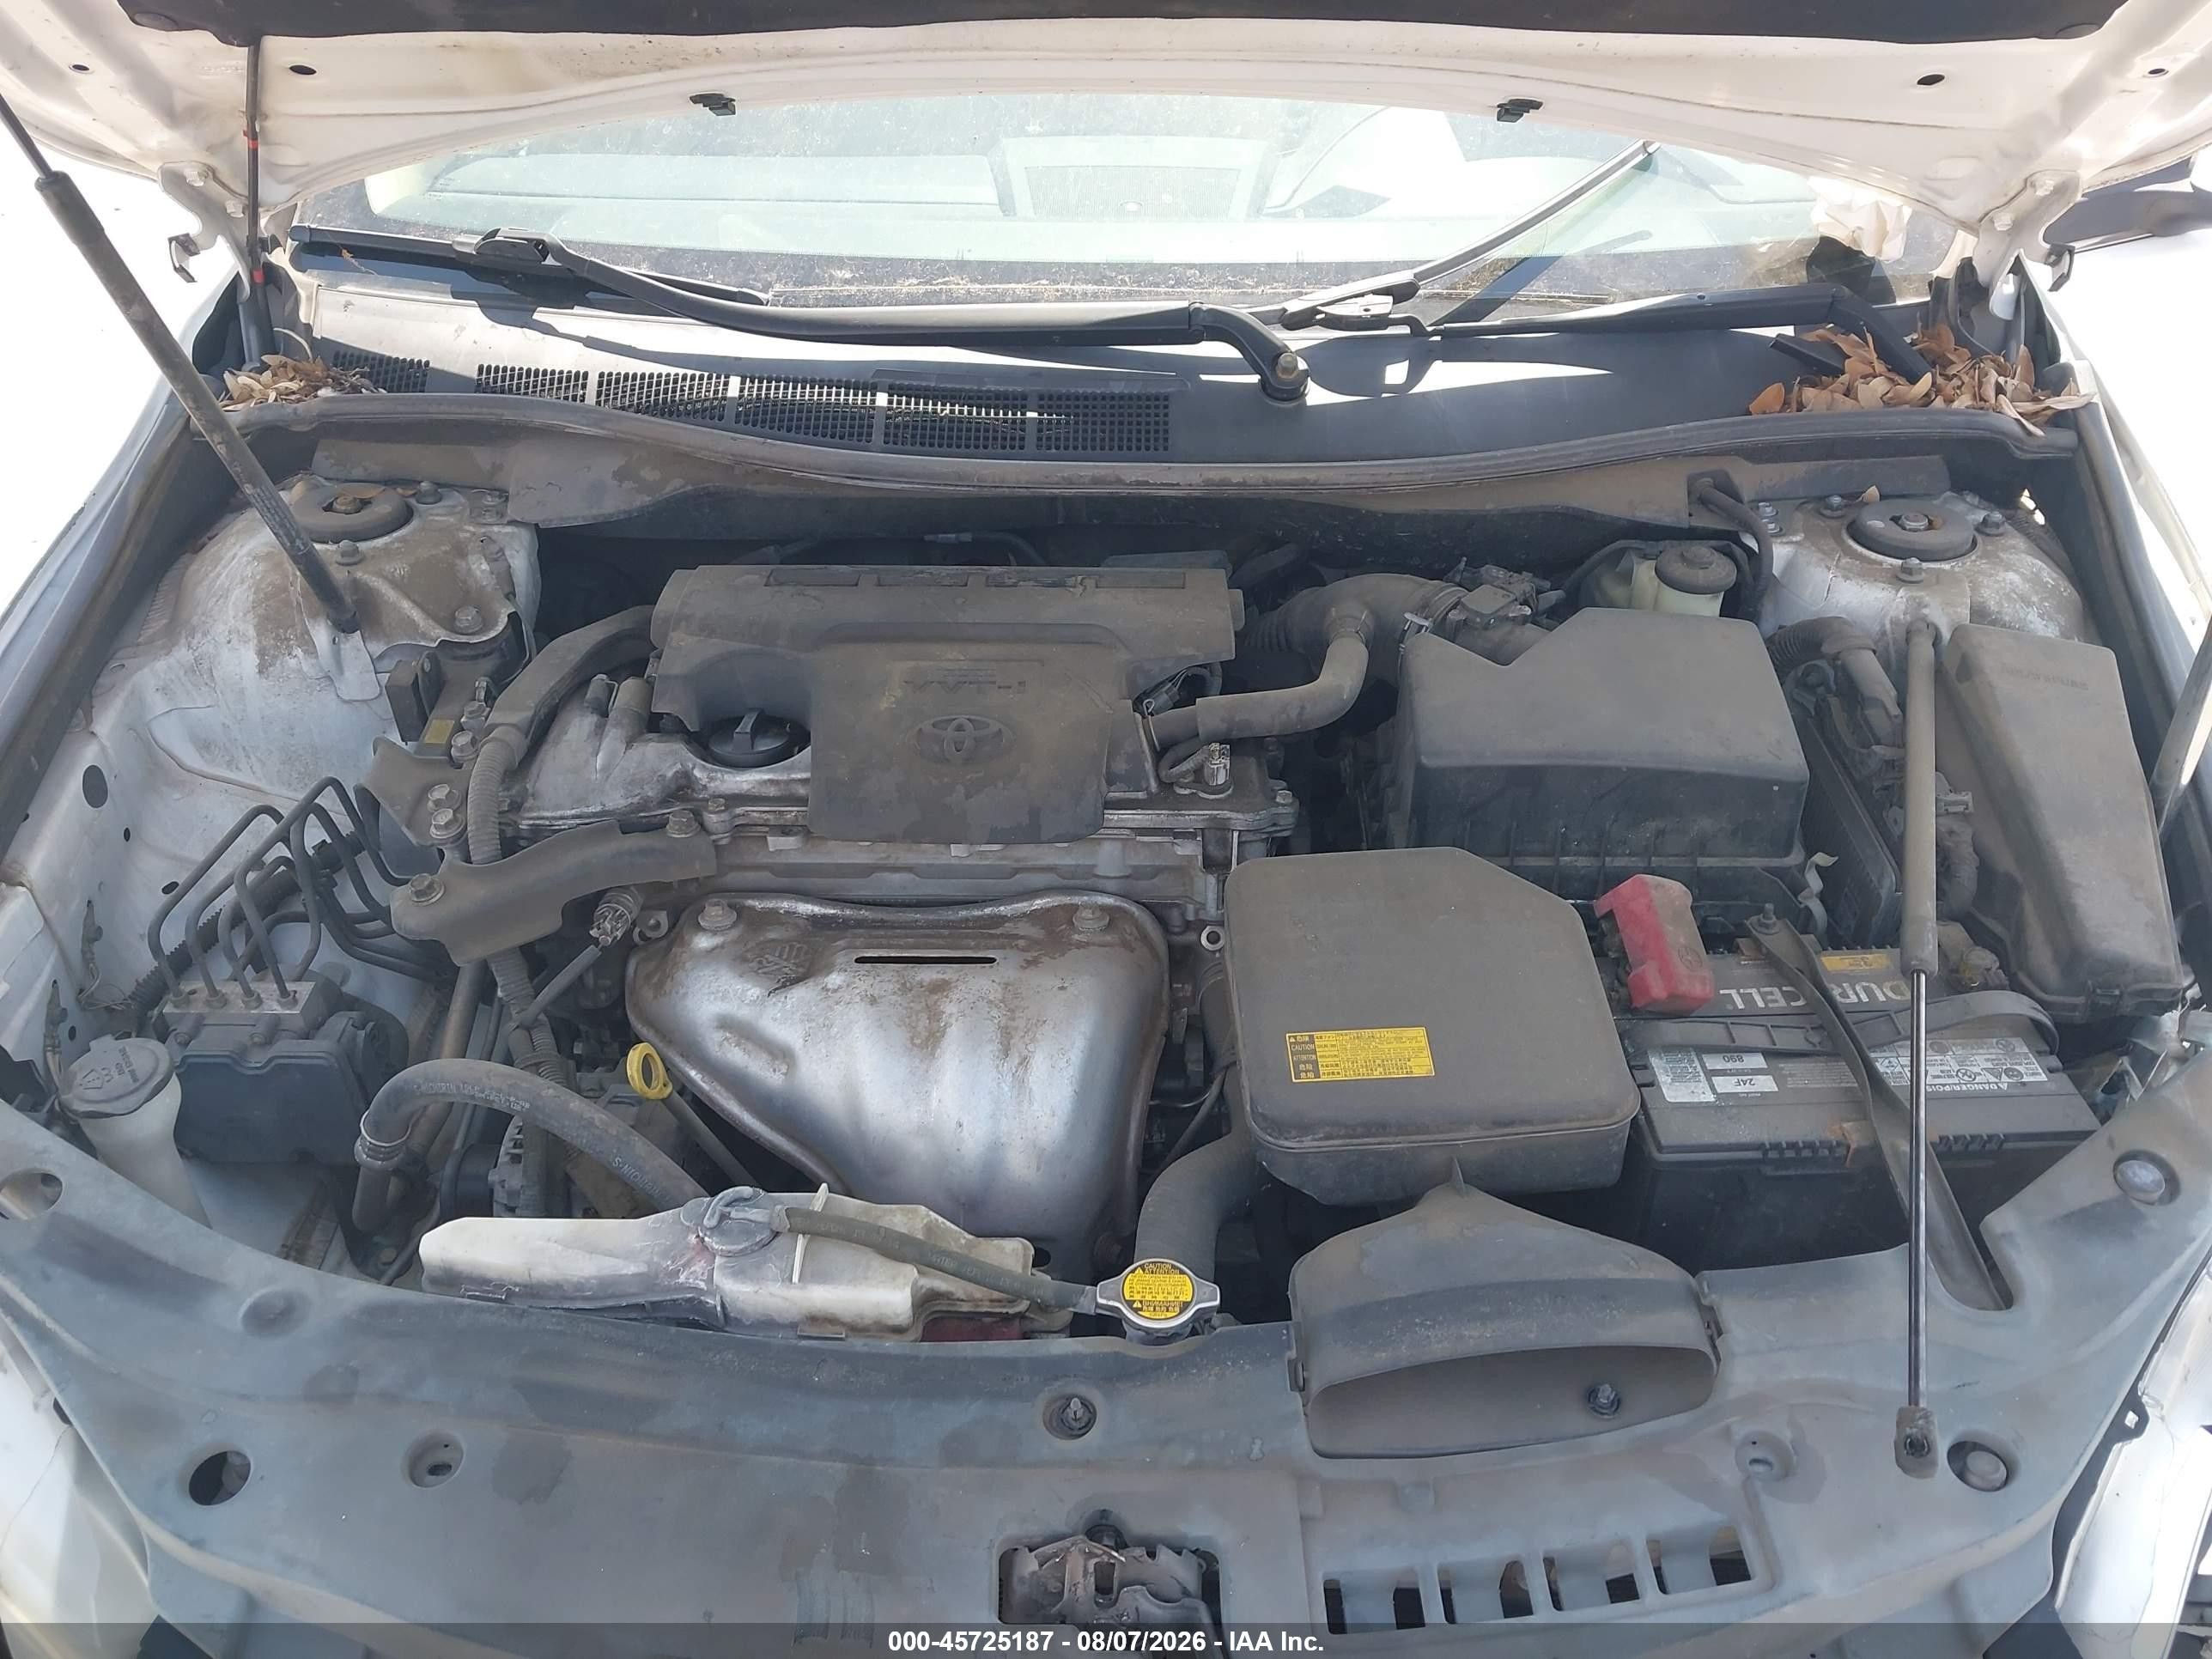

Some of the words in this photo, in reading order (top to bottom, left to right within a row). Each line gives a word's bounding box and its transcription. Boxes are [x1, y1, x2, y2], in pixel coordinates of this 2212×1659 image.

[1720, 981, 1911, 1009] DURCELL
[1291, 1043, 1315, 1052] CAUTION
[1723, 1054, 1745, 1064] 890
[1733, 1078, 1756, 1087] 24F
[1926, 1082, 1998, 1092] DANGER/POIS
